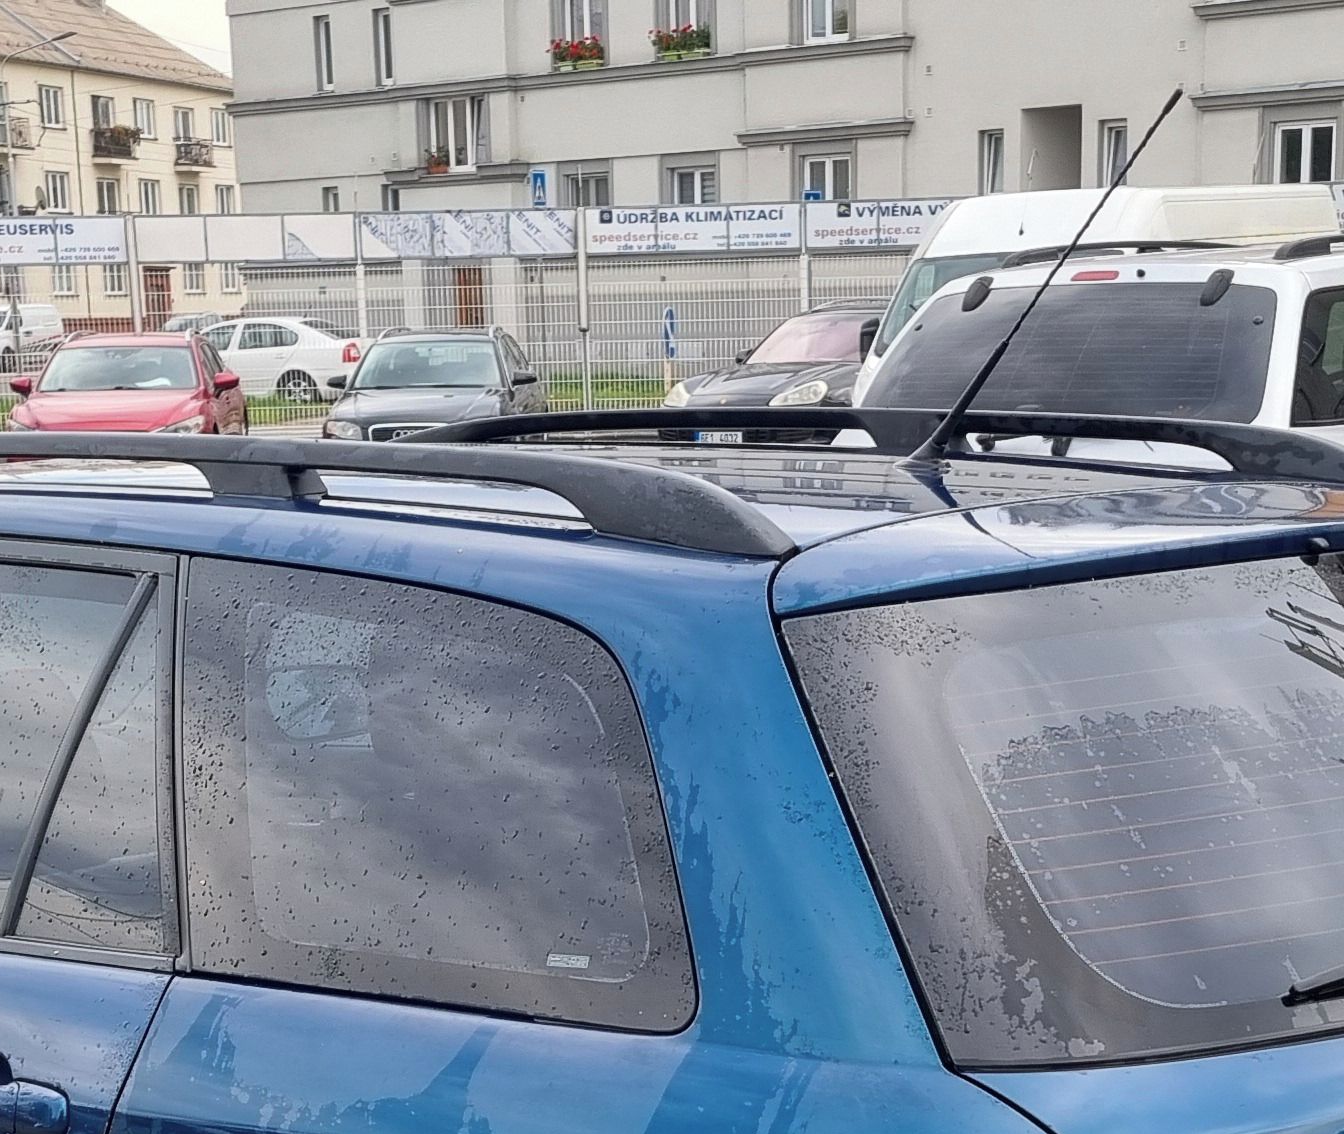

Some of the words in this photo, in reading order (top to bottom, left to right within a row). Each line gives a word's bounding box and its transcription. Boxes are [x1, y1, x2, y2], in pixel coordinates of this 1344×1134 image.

[617, 209, 680, 224] ÚDRŽBA
[685, 206, 784, 223] KLIMATIZACÍ
[856, 203, 923, 218] VÝMĚNA
[546, 210, 573, 235] ENIT
[592, 231, 699, 244] speedservice.cz
[814, 225, 921, 238] speedservice.cz
[617, 243, 634, 251] zde
[839, 238, 855, 246] zde
